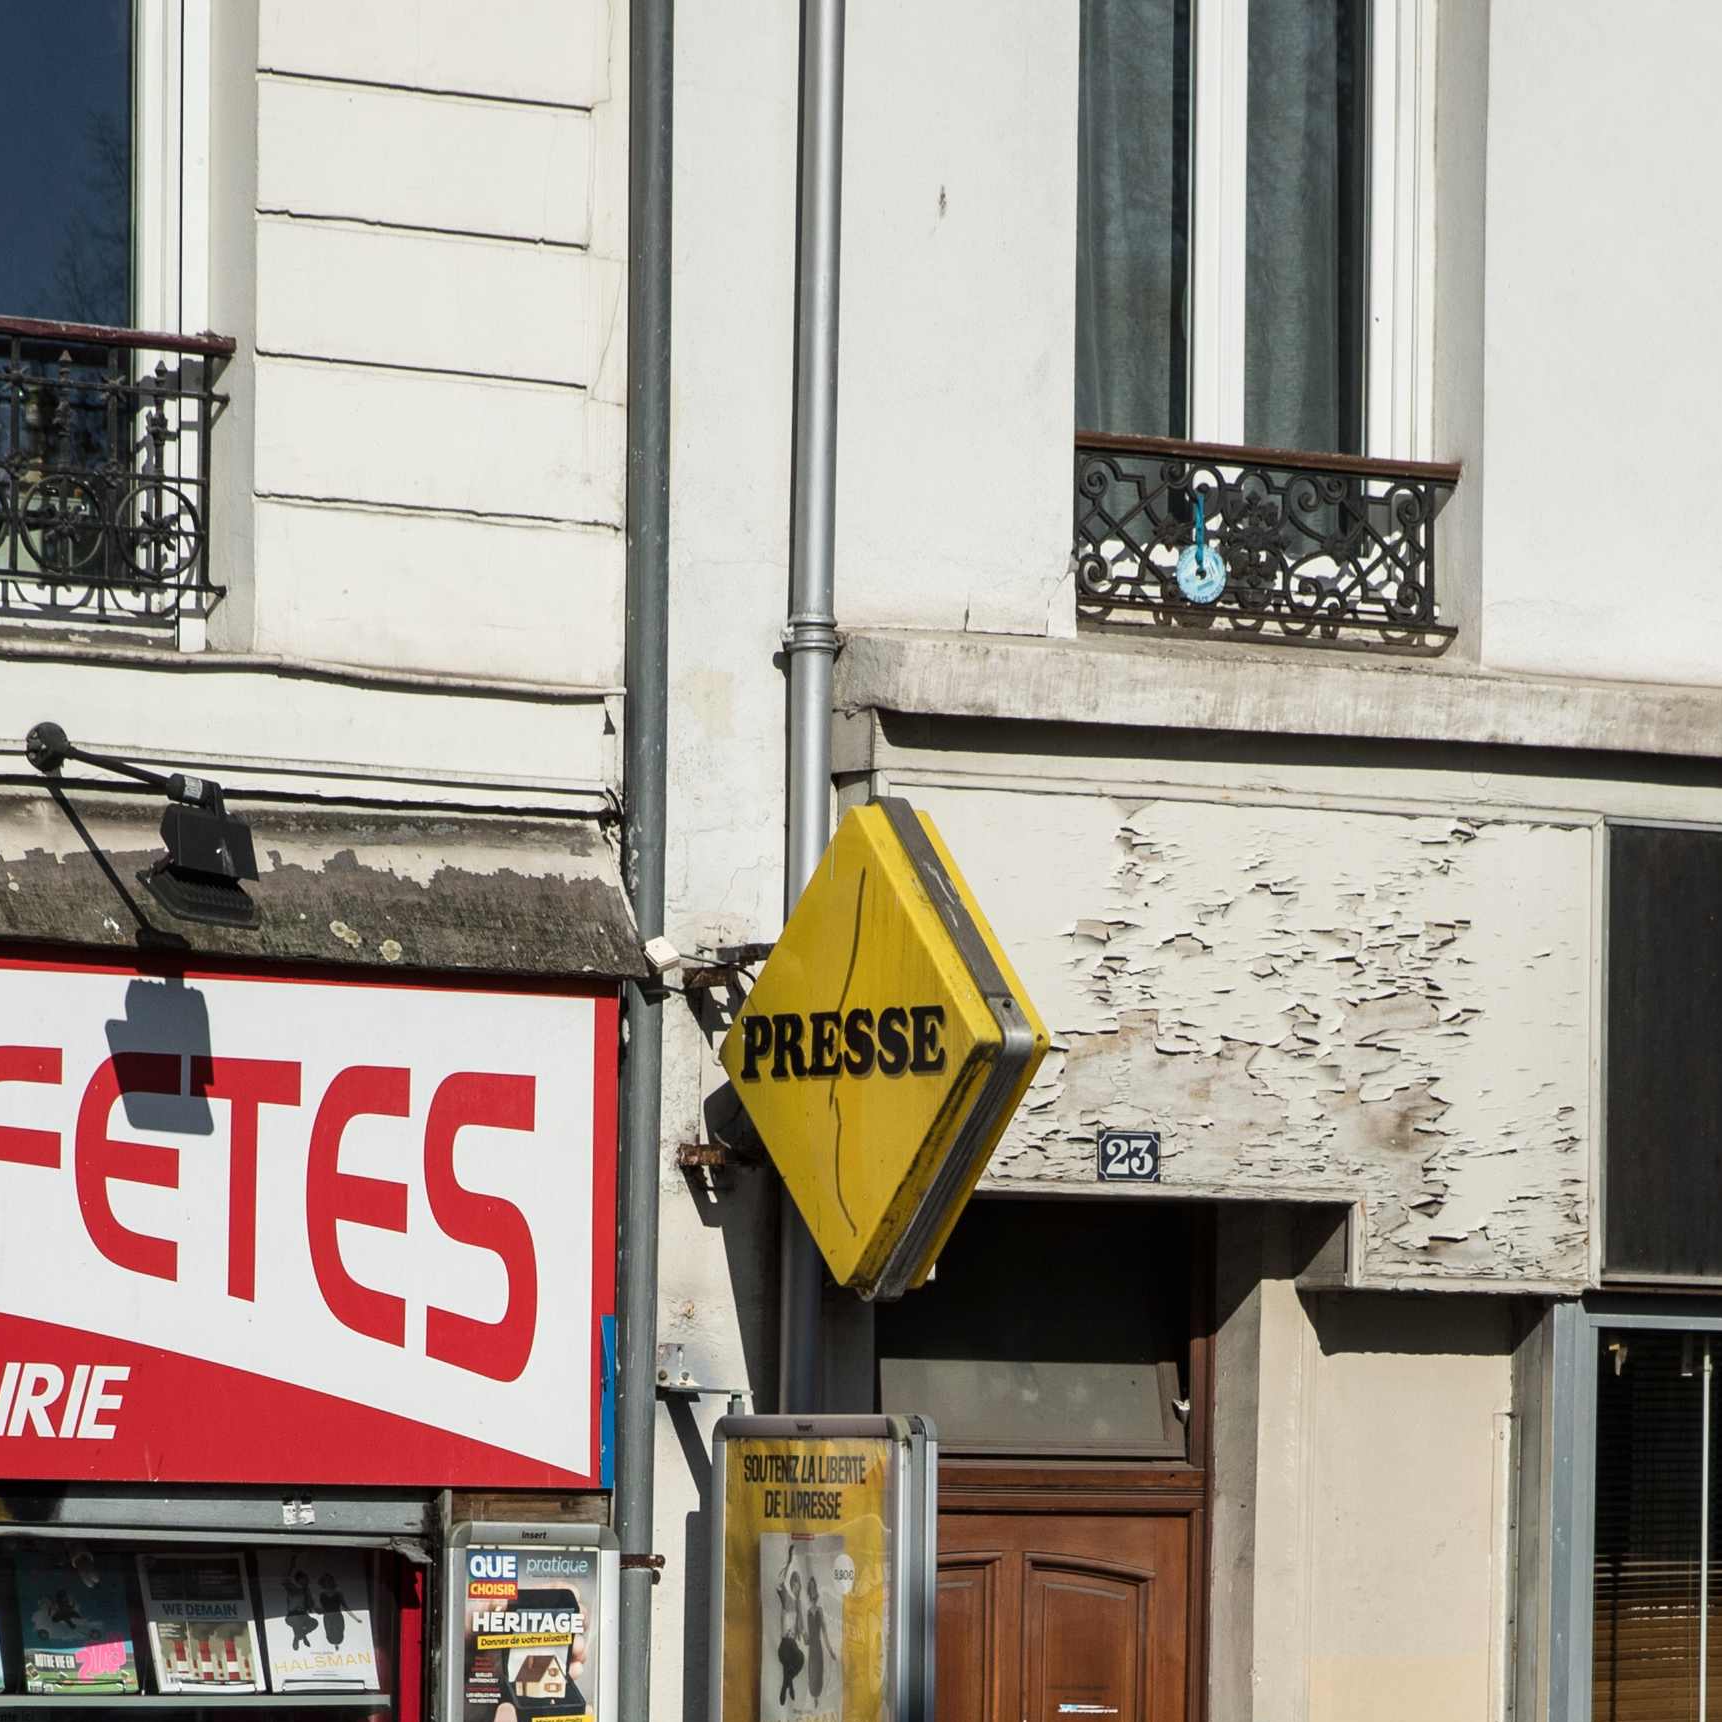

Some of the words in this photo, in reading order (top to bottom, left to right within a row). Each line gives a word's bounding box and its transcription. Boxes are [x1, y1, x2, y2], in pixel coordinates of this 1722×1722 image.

[740, 1005, 947, 1080] PRESSE
[1106, 1139, 1153, 1176] 23
[743, 1454, 799, 1484] SOUTENEZ
[801, 1454, 816, 1484] LA
[817, 1453, 866, 1485] LIBERTÉ
[764, 1490, 781, 1518] DE
[796, 1490, 841, 1520] PRESSE
[469, 1555, 516, 1579] QUE
[526, 1556, 588, 1575] pratique
[469, 1583, 516, 1596] CHOISIR
[162, 1604, 184, 1616] WE
[185, 1602, 238, 1617] DEMAIN
[471, 1608, 584, 1634] HÉRITAGE
[273, 1651, 372, 1674] HALSMAN
